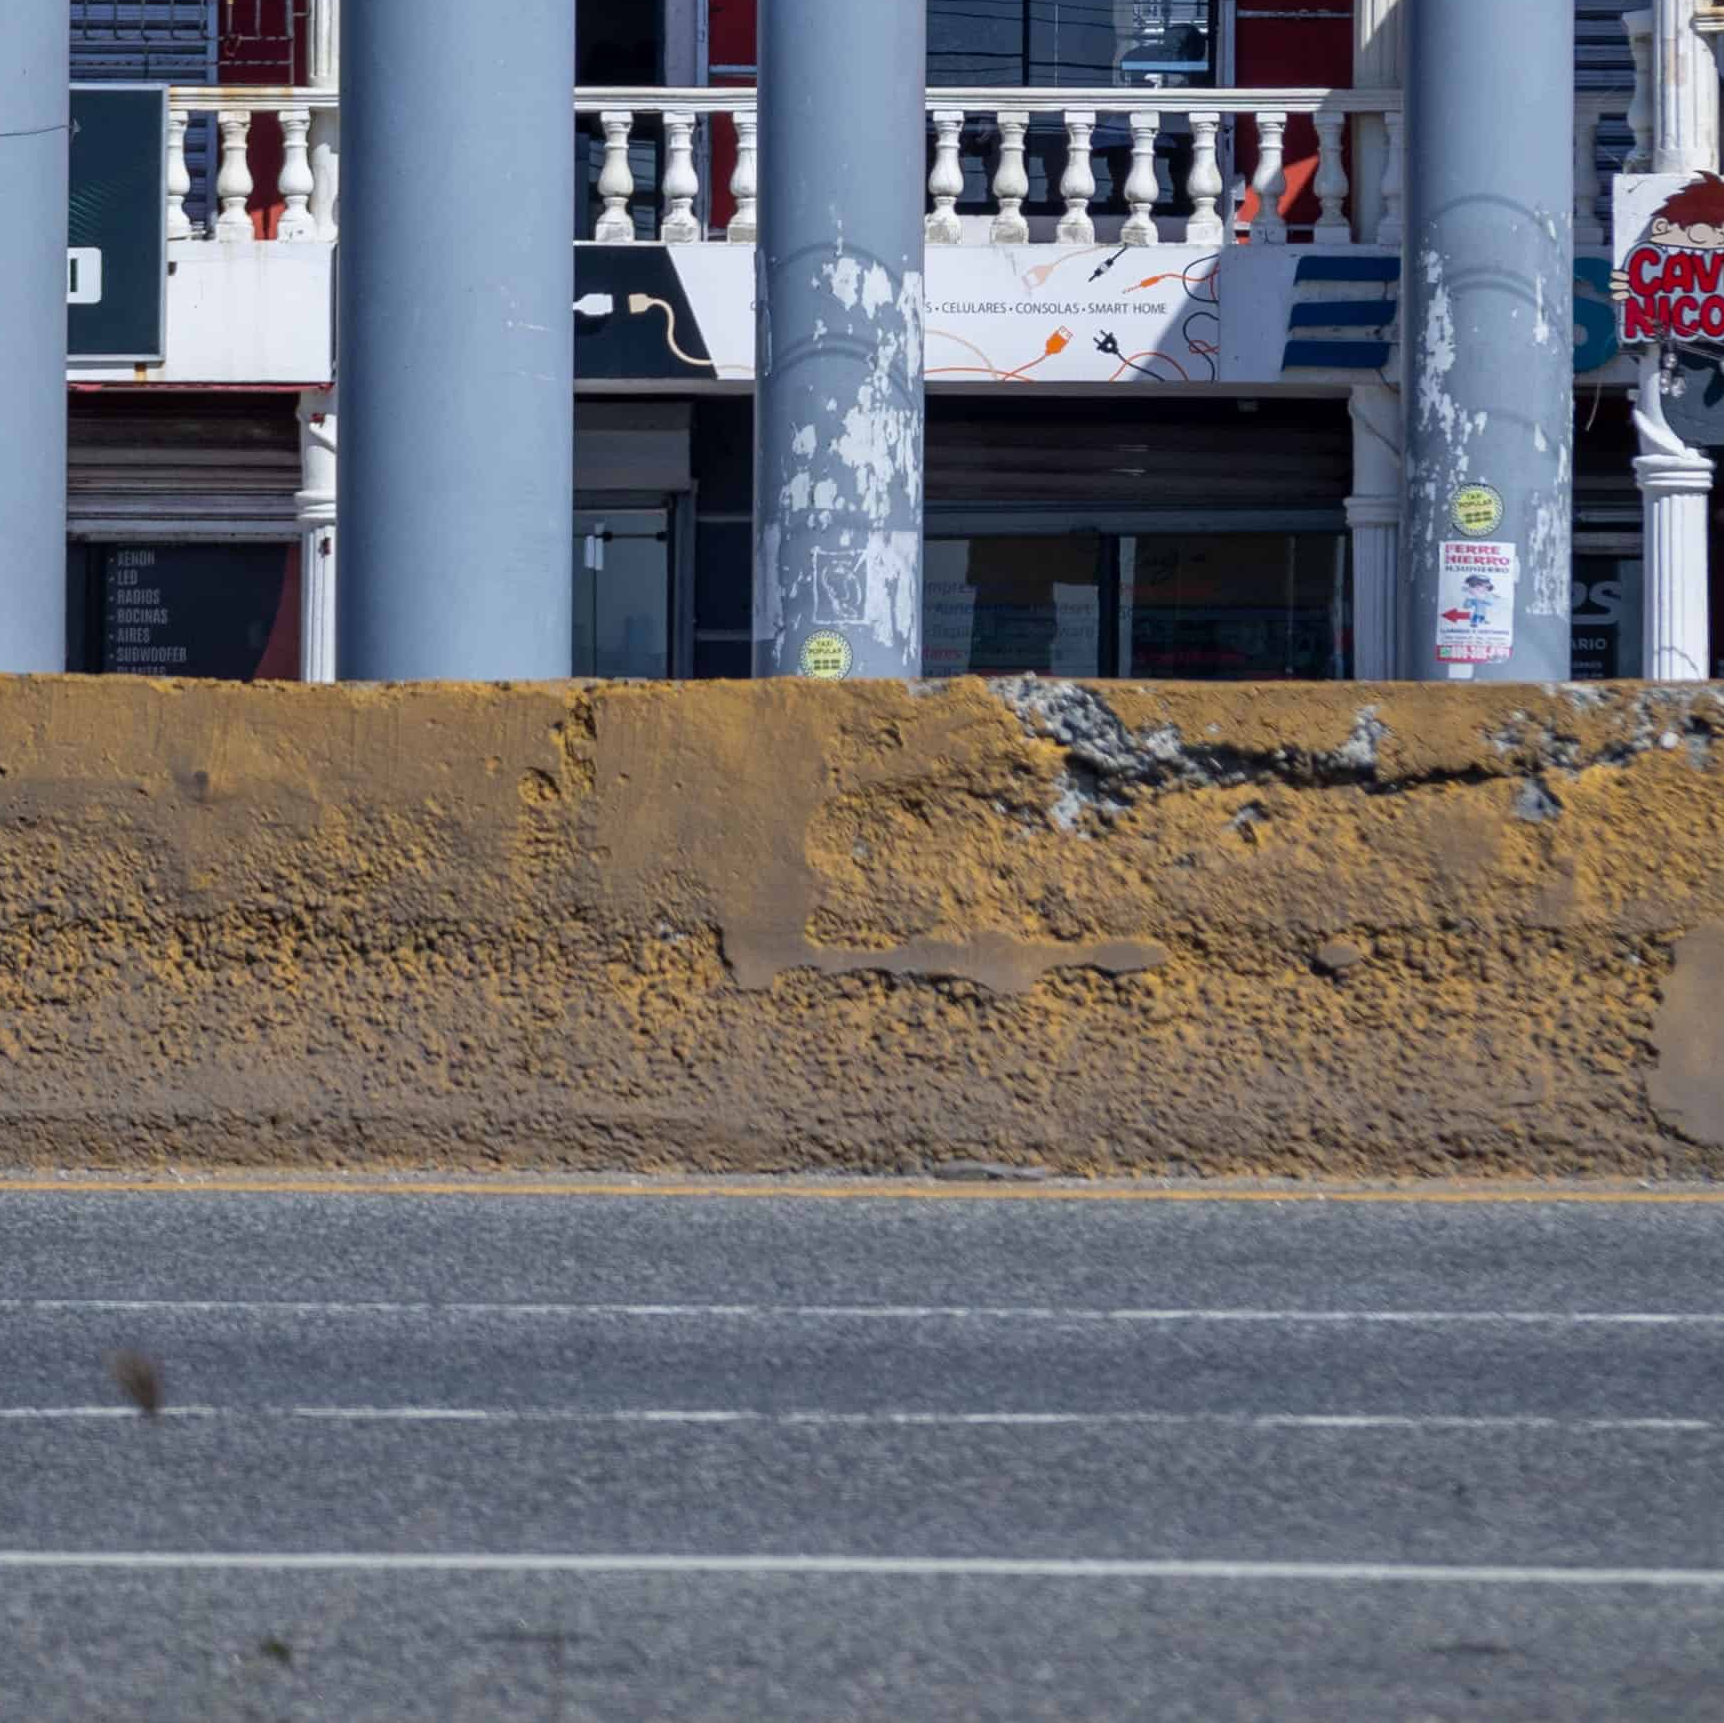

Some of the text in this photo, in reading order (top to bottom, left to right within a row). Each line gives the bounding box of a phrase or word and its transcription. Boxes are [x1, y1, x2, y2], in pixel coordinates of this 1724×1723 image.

[941, 302, 1007, 315] CELULARES
[1015, 302, 1080, 315] CONSOLAS
[1088, 302, 1128, 314] SMART
[1132, 302, 1167, 315] HOME
[117, 570, 139, 586] LED
[117, 588, 161, 605] RADIOS
[117, 608, 169, 624] BOCINAS
[117, 627, 150, 643] AIRES
